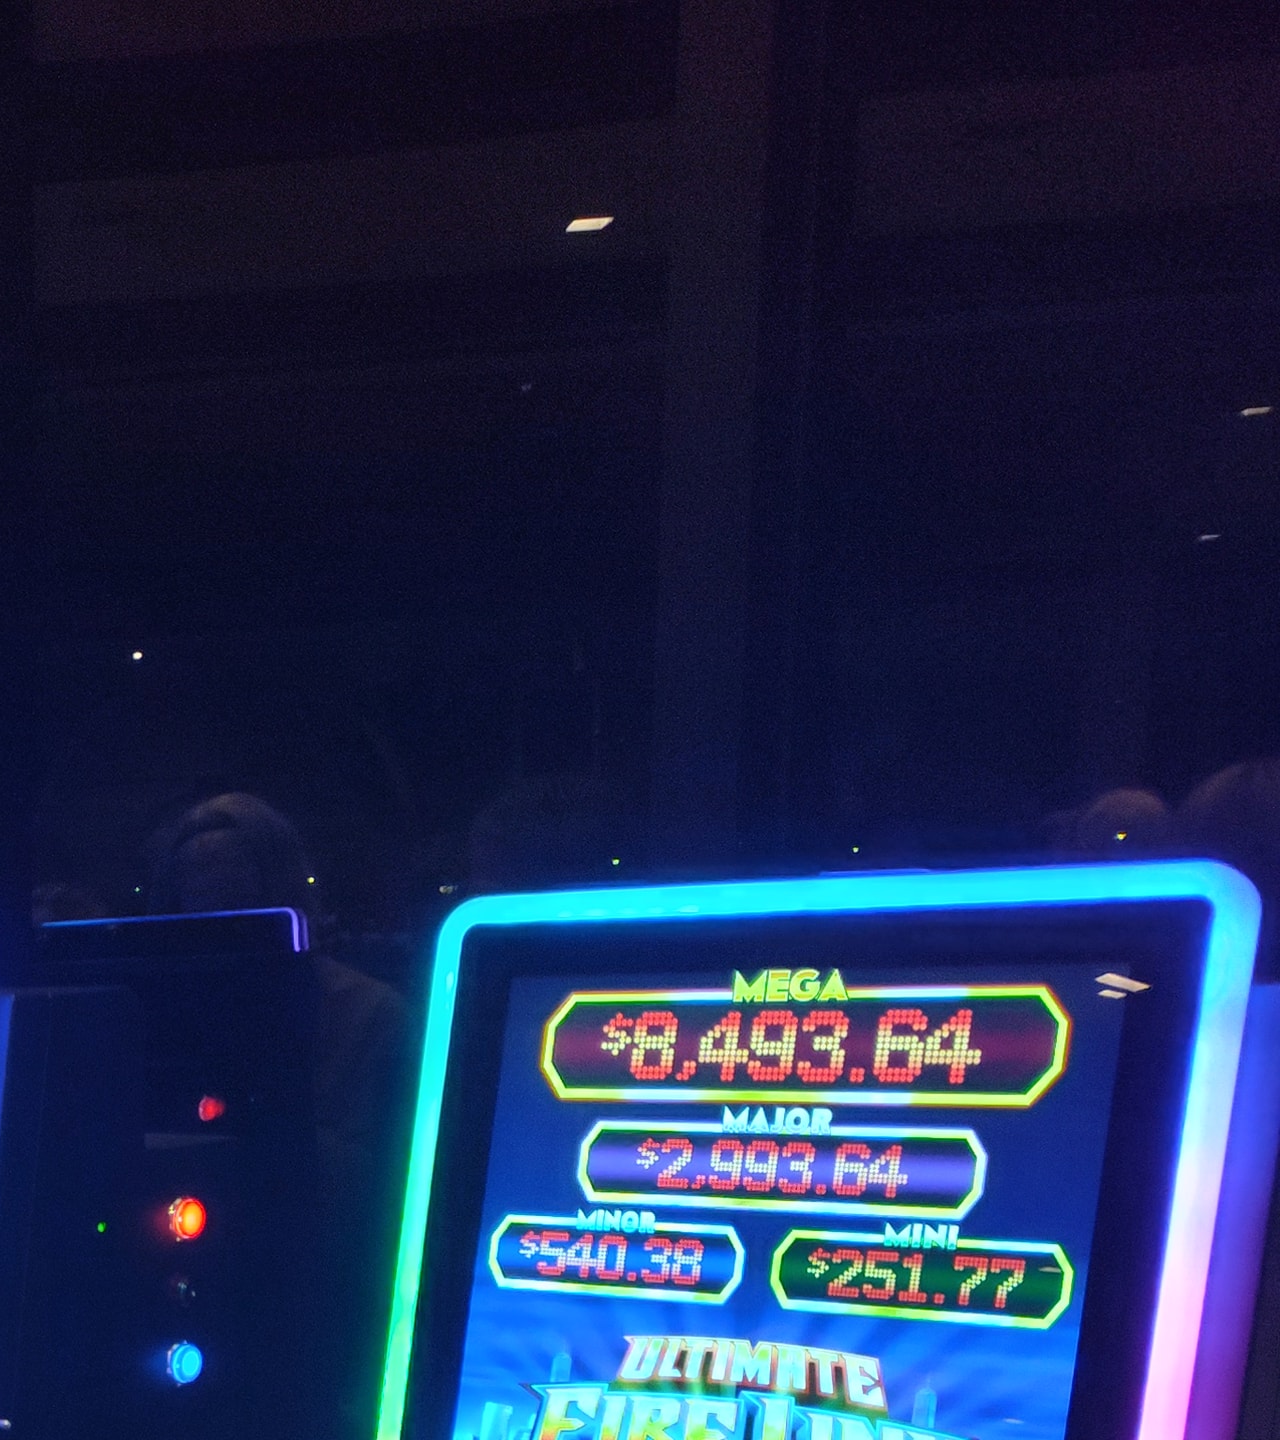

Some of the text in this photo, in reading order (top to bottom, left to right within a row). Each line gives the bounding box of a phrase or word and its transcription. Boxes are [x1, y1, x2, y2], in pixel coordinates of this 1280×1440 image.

[732, 968, 849, 1003] MEGA
[601, 1009, 981, 1084] $8,493.64
[722, 1106, 833, 1135] MAJOR
[636, 1136, 908, 1198] $2,993.64
[576, 1208, 657, 1234] MINOR
[883, 1222, 960, 1250] MINI
[519, 1230, 704, 1286] $540.38
[807, 1247, 1025, 1308] $251.77
[617, 1335, 887, 1408] ULTIMATE
